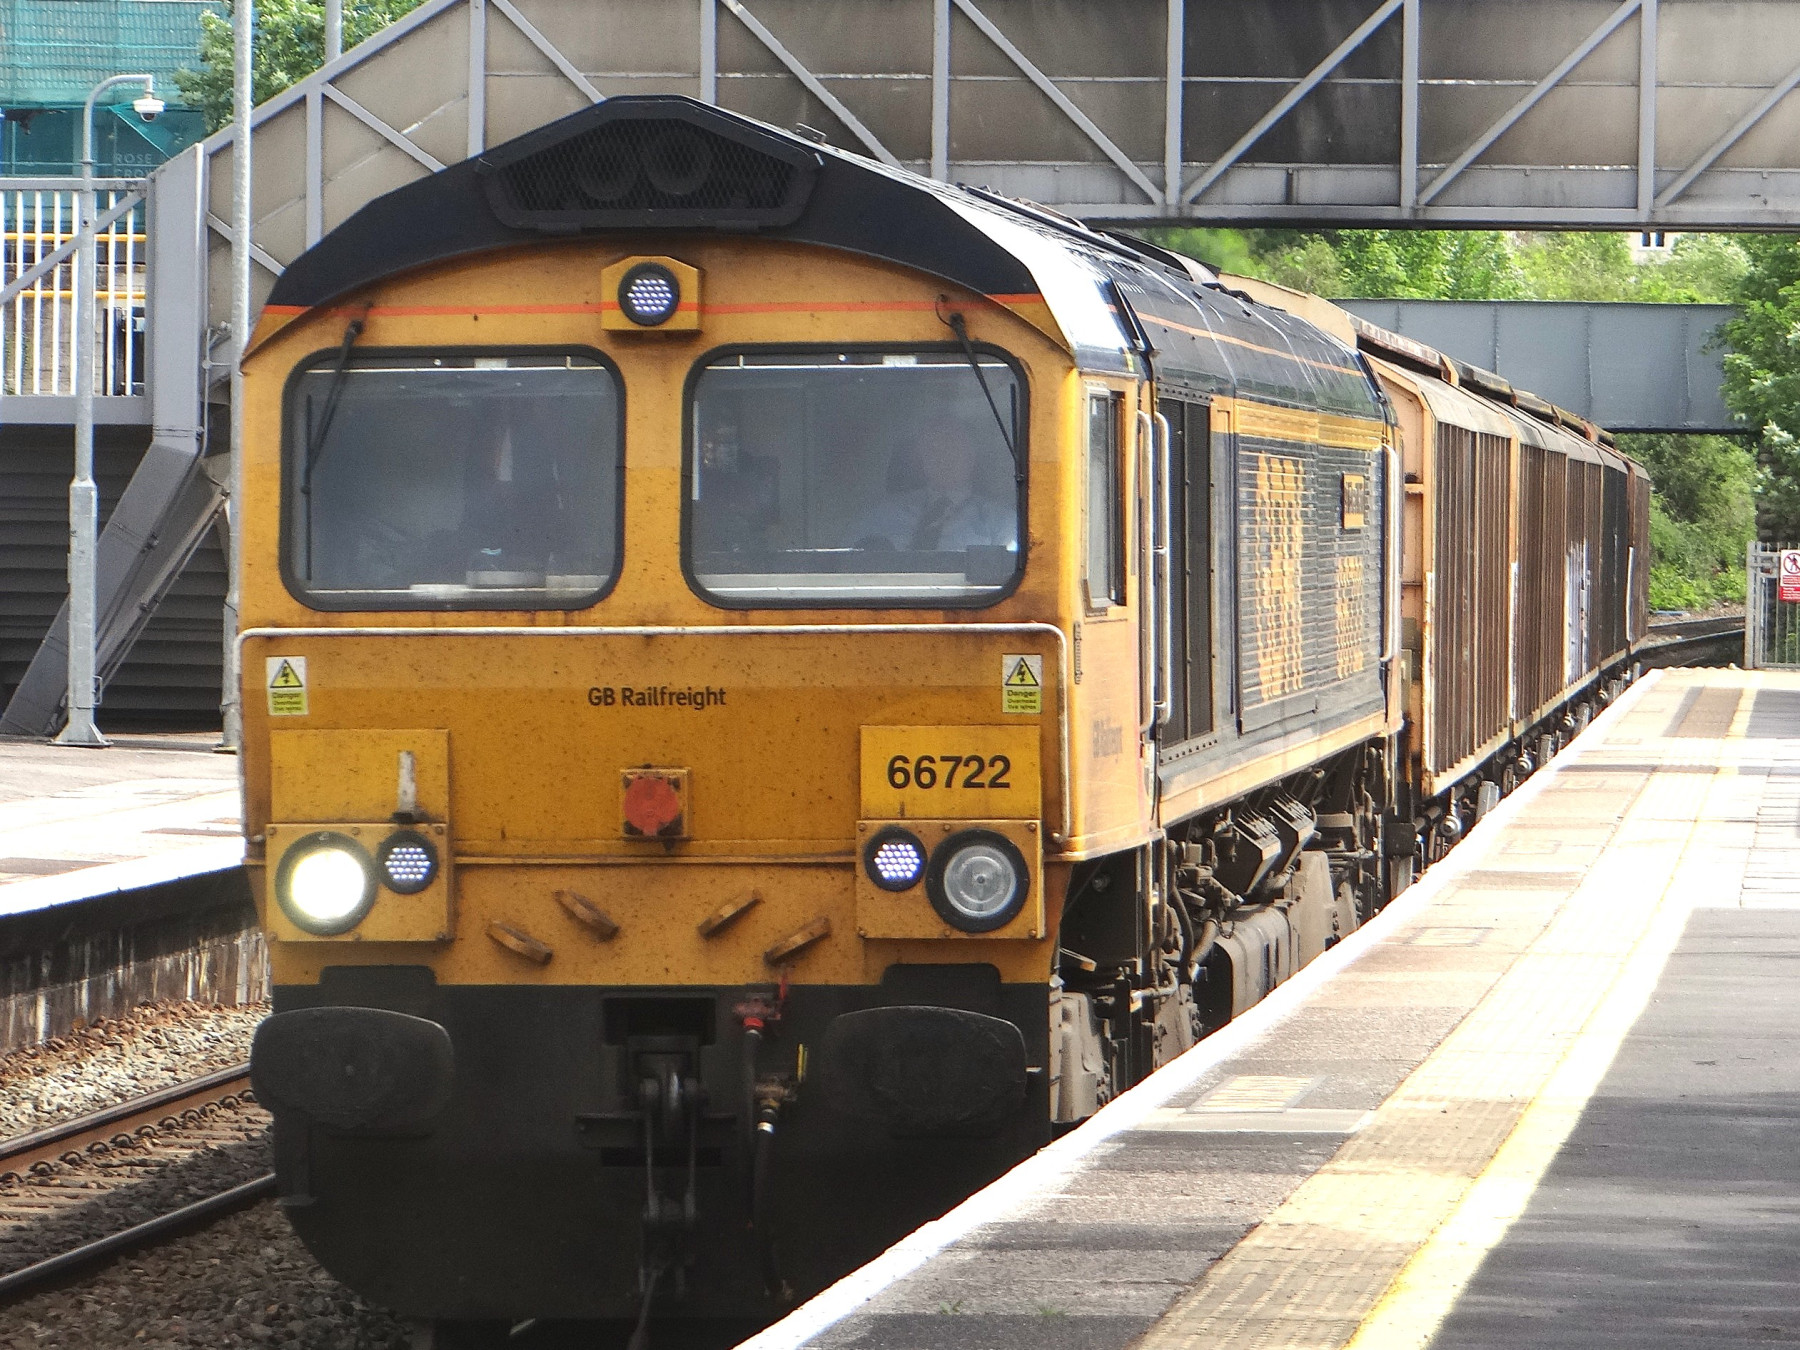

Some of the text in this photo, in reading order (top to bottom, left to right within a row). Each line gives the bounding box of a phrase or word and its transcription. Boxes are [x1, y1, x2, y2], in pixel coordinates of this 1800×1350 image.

[114, 153, 152, 164] ROSE
[588, 686, 726, 710] GB Railfreight
[1006, 689, 1037, 698] Danger
[887, 754, 1011, 789] 66722
